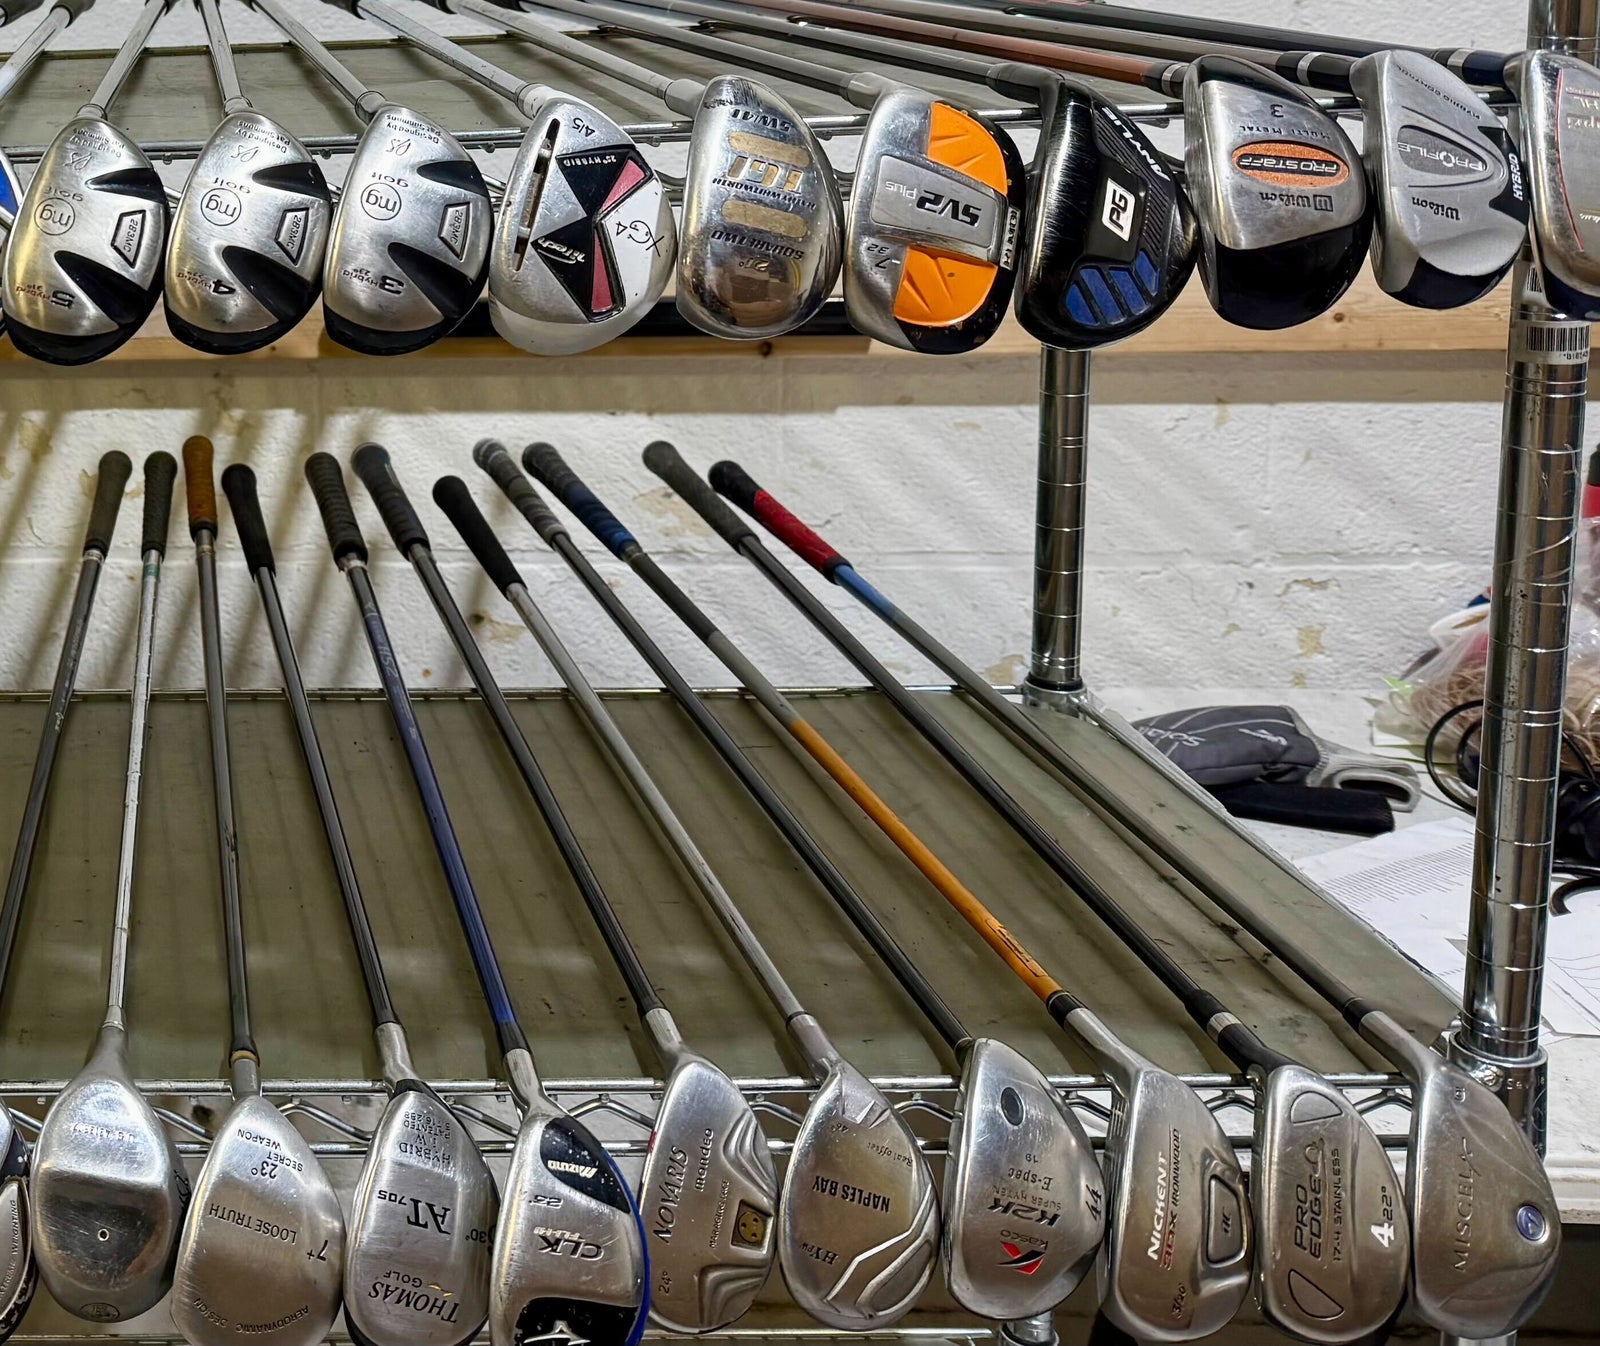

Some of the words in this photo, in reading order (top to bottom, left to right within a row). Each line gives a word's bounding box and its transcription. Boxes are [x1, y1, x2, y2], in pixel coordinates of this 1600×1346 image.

[1269, 103, 1285, 119] 3
[571, 116, 596, 139] 4/5
[1238, 124, 1284, 137] METAL
[563, 156, 602, 168] HYBRID
[1299, 159, 1338, 174] PRO
[1396, 140, 1487, 173] PROFILE
[211, 176, 251, 194] golf
[371, 170, 409, 188] golf
[1507, 152, 1524, 201] HYBRID
[44, 186, 84, 202] golf
[365, 190, 398, 214] mg
[885, 179, 919, 202] plus
[1259, 191, 1312, 209] Wilson
[40, 204, 71, 227] mg
[204, 194, 238, 218] mg
[1411, 195, 1462, 221] Wilson
[710, 228, 752, 249] TWO
[753, 236, 806, 261] SQUARE
[874, 256, 892, 271] 7
[211, 278, 236, 296] 4
[341, 269, 379, 289] Hybrid
[378, 274, 405, 296] 3
[51, 290, 77, 310] 5
[237, 1127, 282, 1151] WEAPON
[265, 1149, 303, 1172] SECRET
[399, 1142, 451, 1162] HYBRID
[250, 1160, 279, 1180] 23°
[1007, 1167, 1054, 1192] E-spec
[1171, 1127, 1182, 1208] IRONWOOD
[652, 1146, 689, 1246] NOVARIS
[811, 1174, 841, 1197] BAY
[1330, 1147, 1345, 1226] STAINLESS
[840, 1184, 891, 1213] NAPLES
[1084, 1182, 1102, 1222] 44
[1147, 1150, 1170, 1263] NICKENT
[1381, 1185, 1394, 1222] 22°
[208, 1202, 253, 1230] TRUTH
[986, 1196, 1062, 1228] K2K
[1293, 1183, 1310, 1253] PRO
[1308, 1173, 1324, 1261] EDGE
[11, 1198, 21, 1256] WEIGHTING
[253, 1217, 298, 1244] LOOSE
[1370, 1221, 1396, 1249] 4
[538, 1235, 605, 1262] CLK
[1331, 1226, 1344, 1263] 17-4
[382, 1270, 423, 1287] GOLF
[658, 1270, 673, 1295] 24°
[368, 1280, 460, 1323] THOMAS
